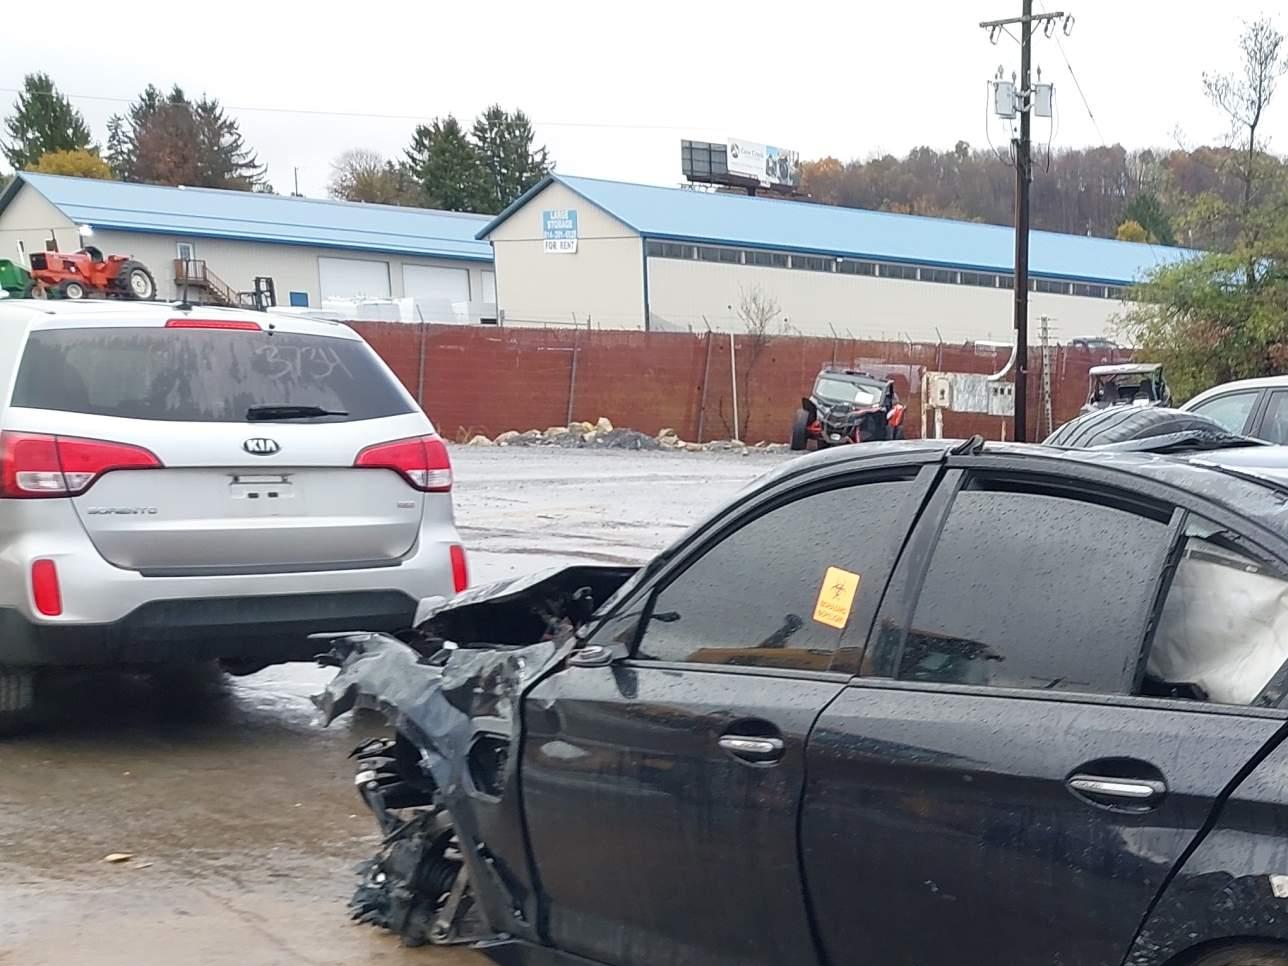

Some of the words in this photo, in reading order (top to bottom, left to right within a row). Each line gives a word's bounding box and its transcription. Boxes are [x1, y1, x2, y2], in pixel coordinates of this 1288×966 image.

[545, 240, 557, 250] FOR
[560, 240, 575, 250] RENT
[246, 438, 278, 452] KIA
[87, 506, 159, 515] SORENTO
